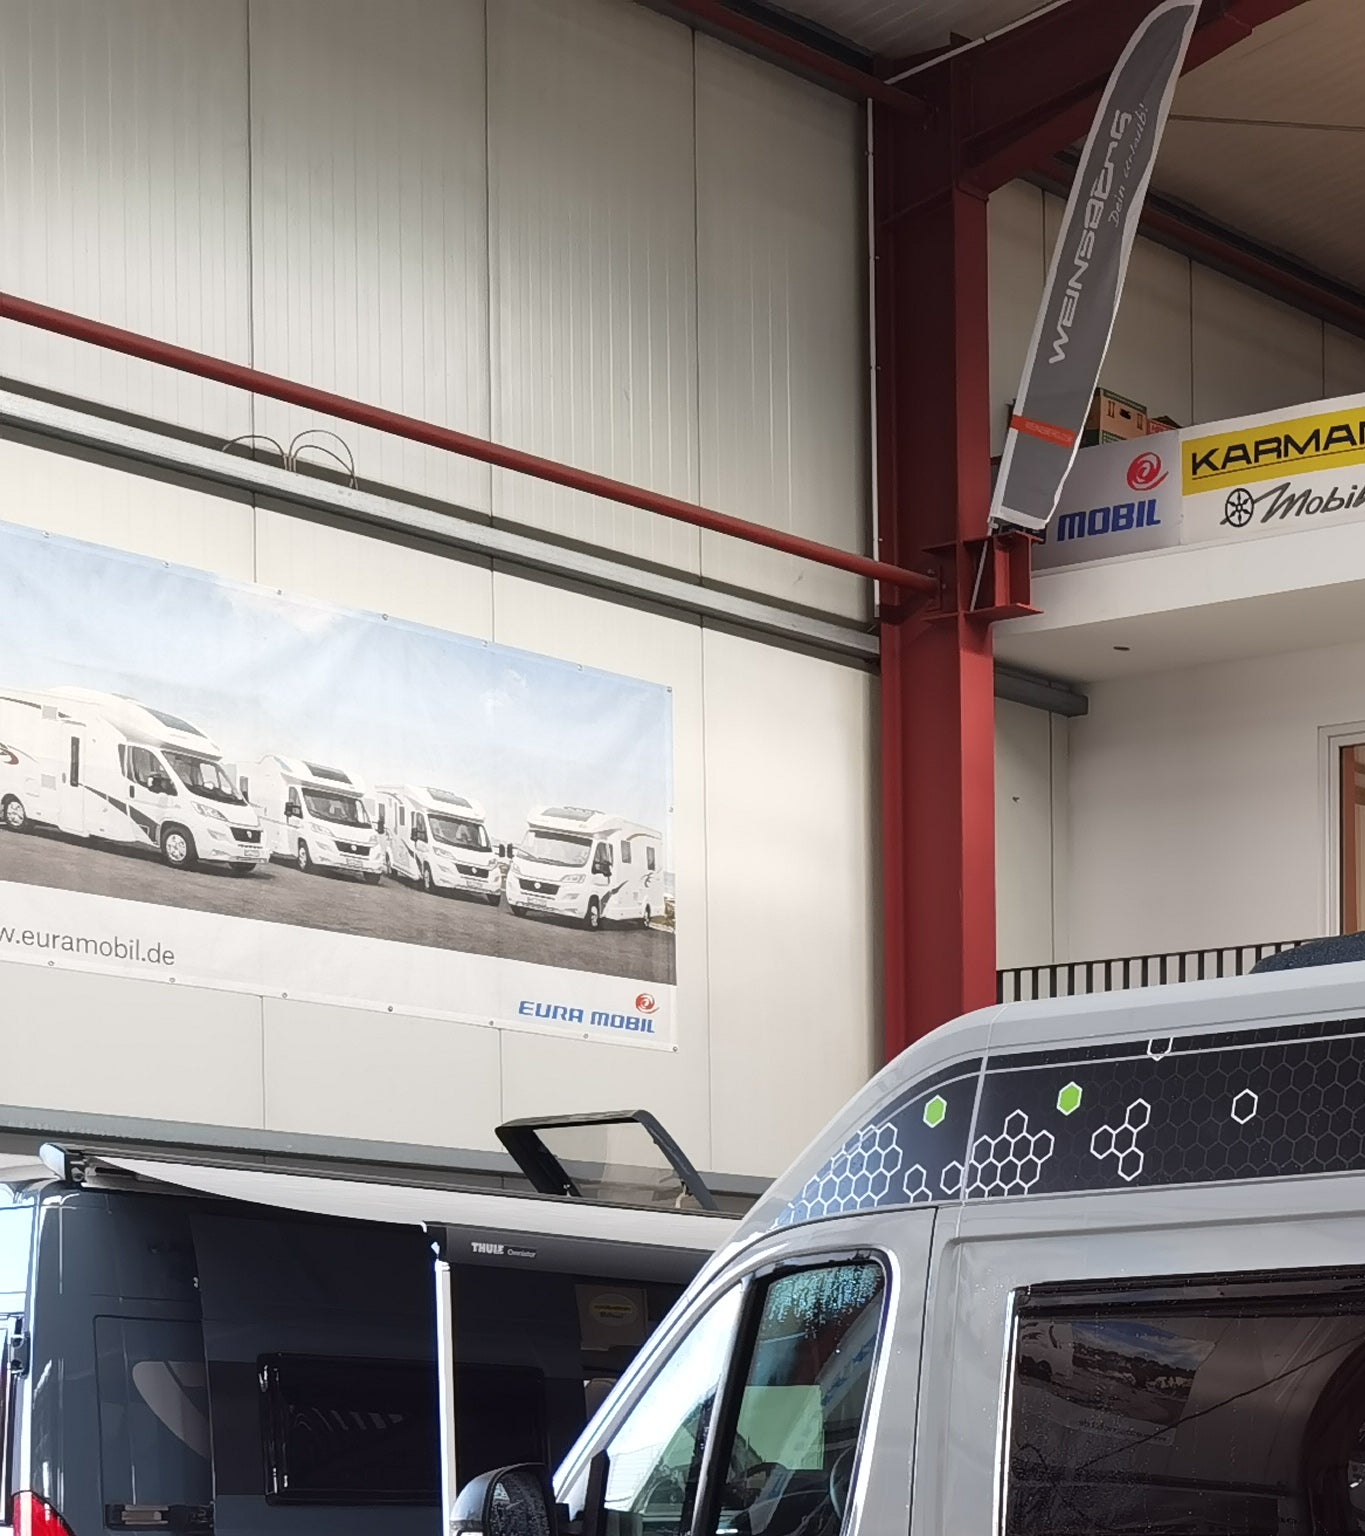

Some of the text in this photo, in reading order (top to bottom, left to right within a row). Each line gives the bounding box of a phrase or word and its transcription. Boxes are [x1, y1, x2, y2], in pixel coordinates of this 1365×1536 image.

[1057, 499, 1161, 542] MOBIL
[518, 1000, 655, 1033] EURA MOBIL
[471, 1242, 504, 1255] THULE
